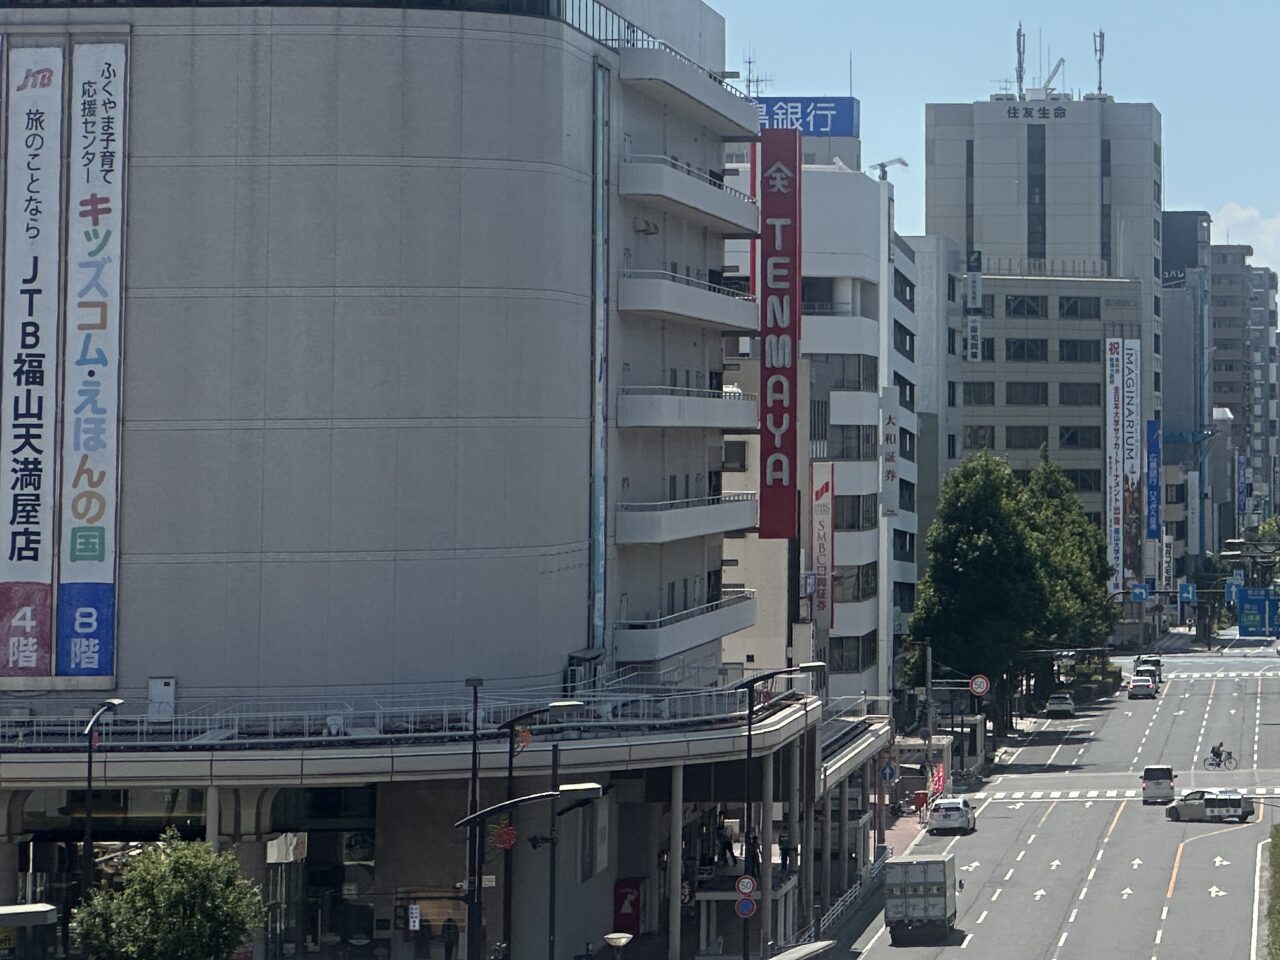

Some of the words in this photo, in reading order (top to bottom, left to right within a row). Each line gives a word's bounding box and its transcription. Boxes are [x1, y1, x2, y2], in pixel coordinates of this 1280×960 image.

[16, 67, 54, 92] JTB
[1006, 105, 1067, 120] 住友生命
[81, 80, 97, 185] 応援センター
[100, 62, 117, 185] ふくやま子育て
[25, 111, 45, 240] 旅のことなら
[69, 193, 113, 564] キッズコム・えほんの国
[764, 216, 791, 488] TENMAYA
[1109, 341, 1120, 356] 祝
[8, 256, 45, 564] JTB福山天満屋店
[1125, 347, 1135, 460] IMAGINARIUM
[885, 413, 897, 482] 大和証券
[8, 607, 38, 669] 4階
[69, 607, 100, 670] 8階
[974, 681, 985, 690] 50
[740, 880, 752, 890] 50
